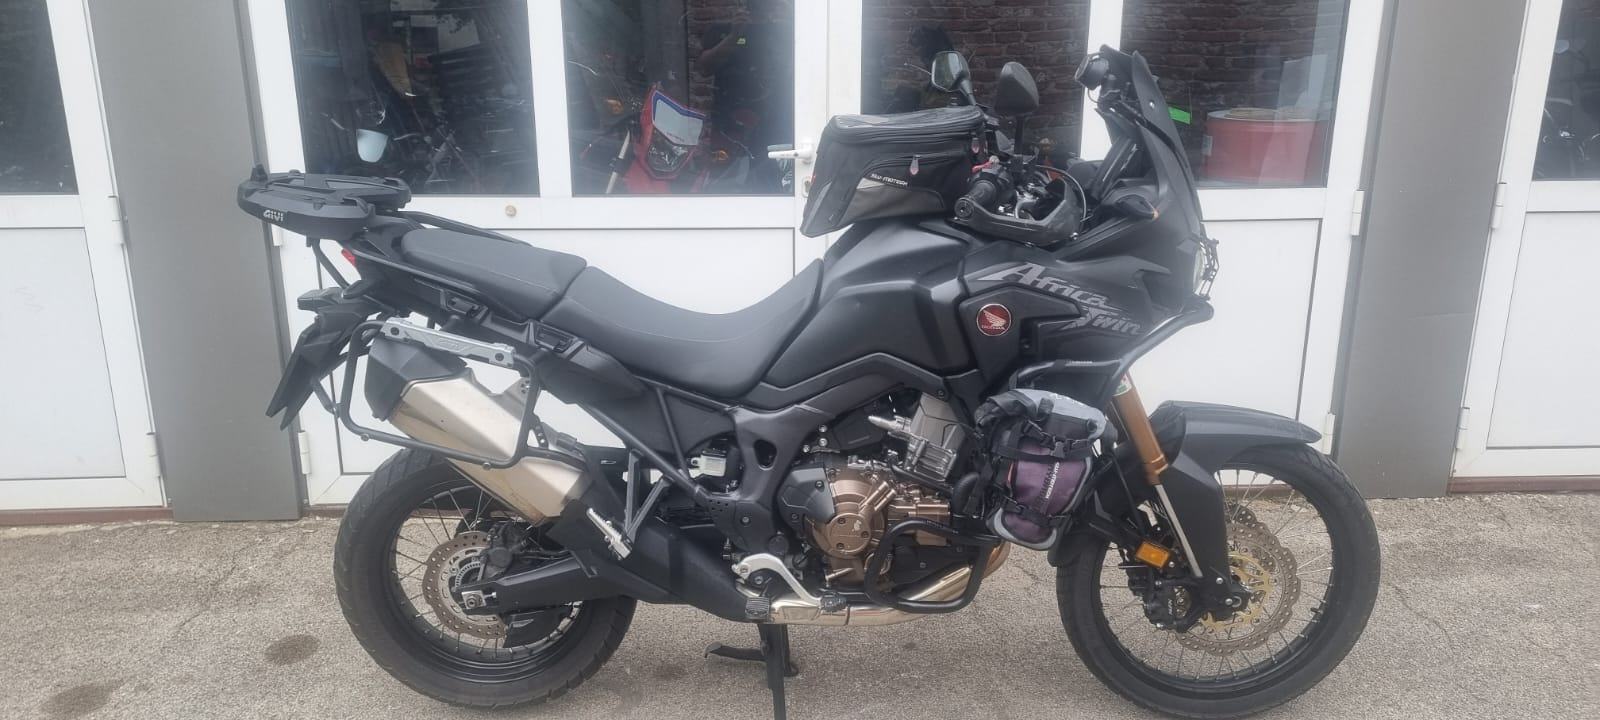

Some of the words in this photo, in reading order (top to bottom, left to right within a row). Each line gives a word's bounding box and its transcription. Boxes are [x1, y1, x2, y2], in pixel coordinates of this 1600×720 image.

[263, 209, 284, 222] GIVI
[977, 262, 1118, 311] Africa
[1061, 306, 1146, 335] Twin
